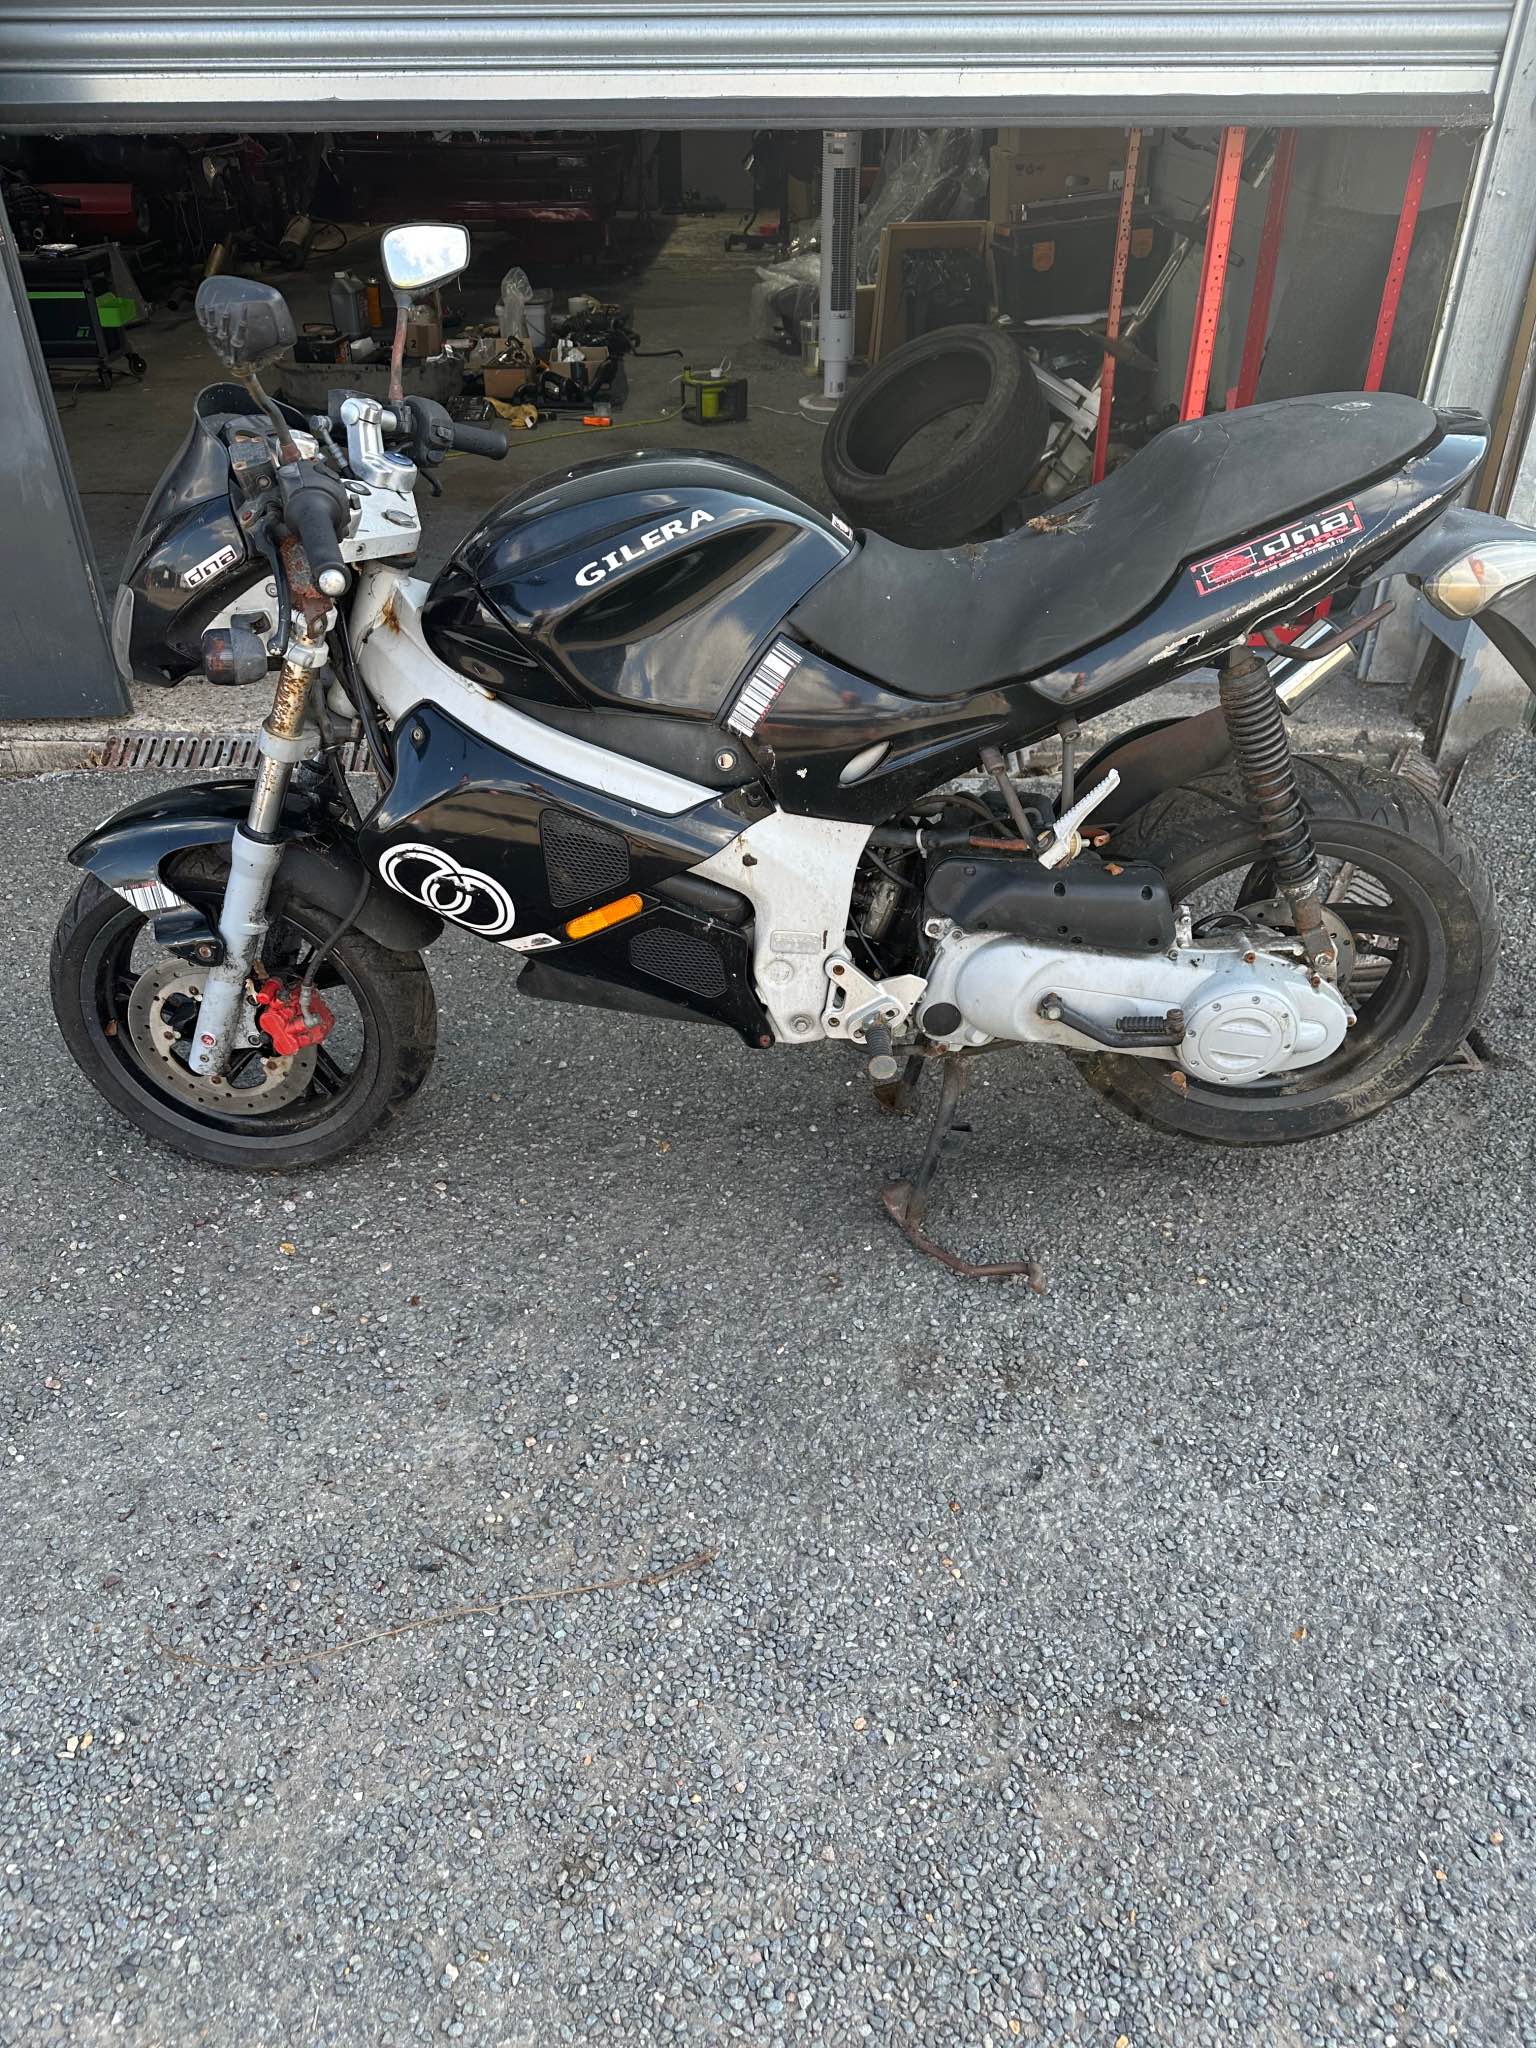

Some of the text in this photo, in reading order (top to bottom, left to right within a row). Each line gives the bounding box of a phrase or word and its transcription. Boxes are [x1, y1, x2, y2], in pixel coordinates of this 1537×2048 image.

[575, 509, 715, 586] GILERA
[1262, 511, 1349, 557] dna
[188, 550, 236, 586] dna
